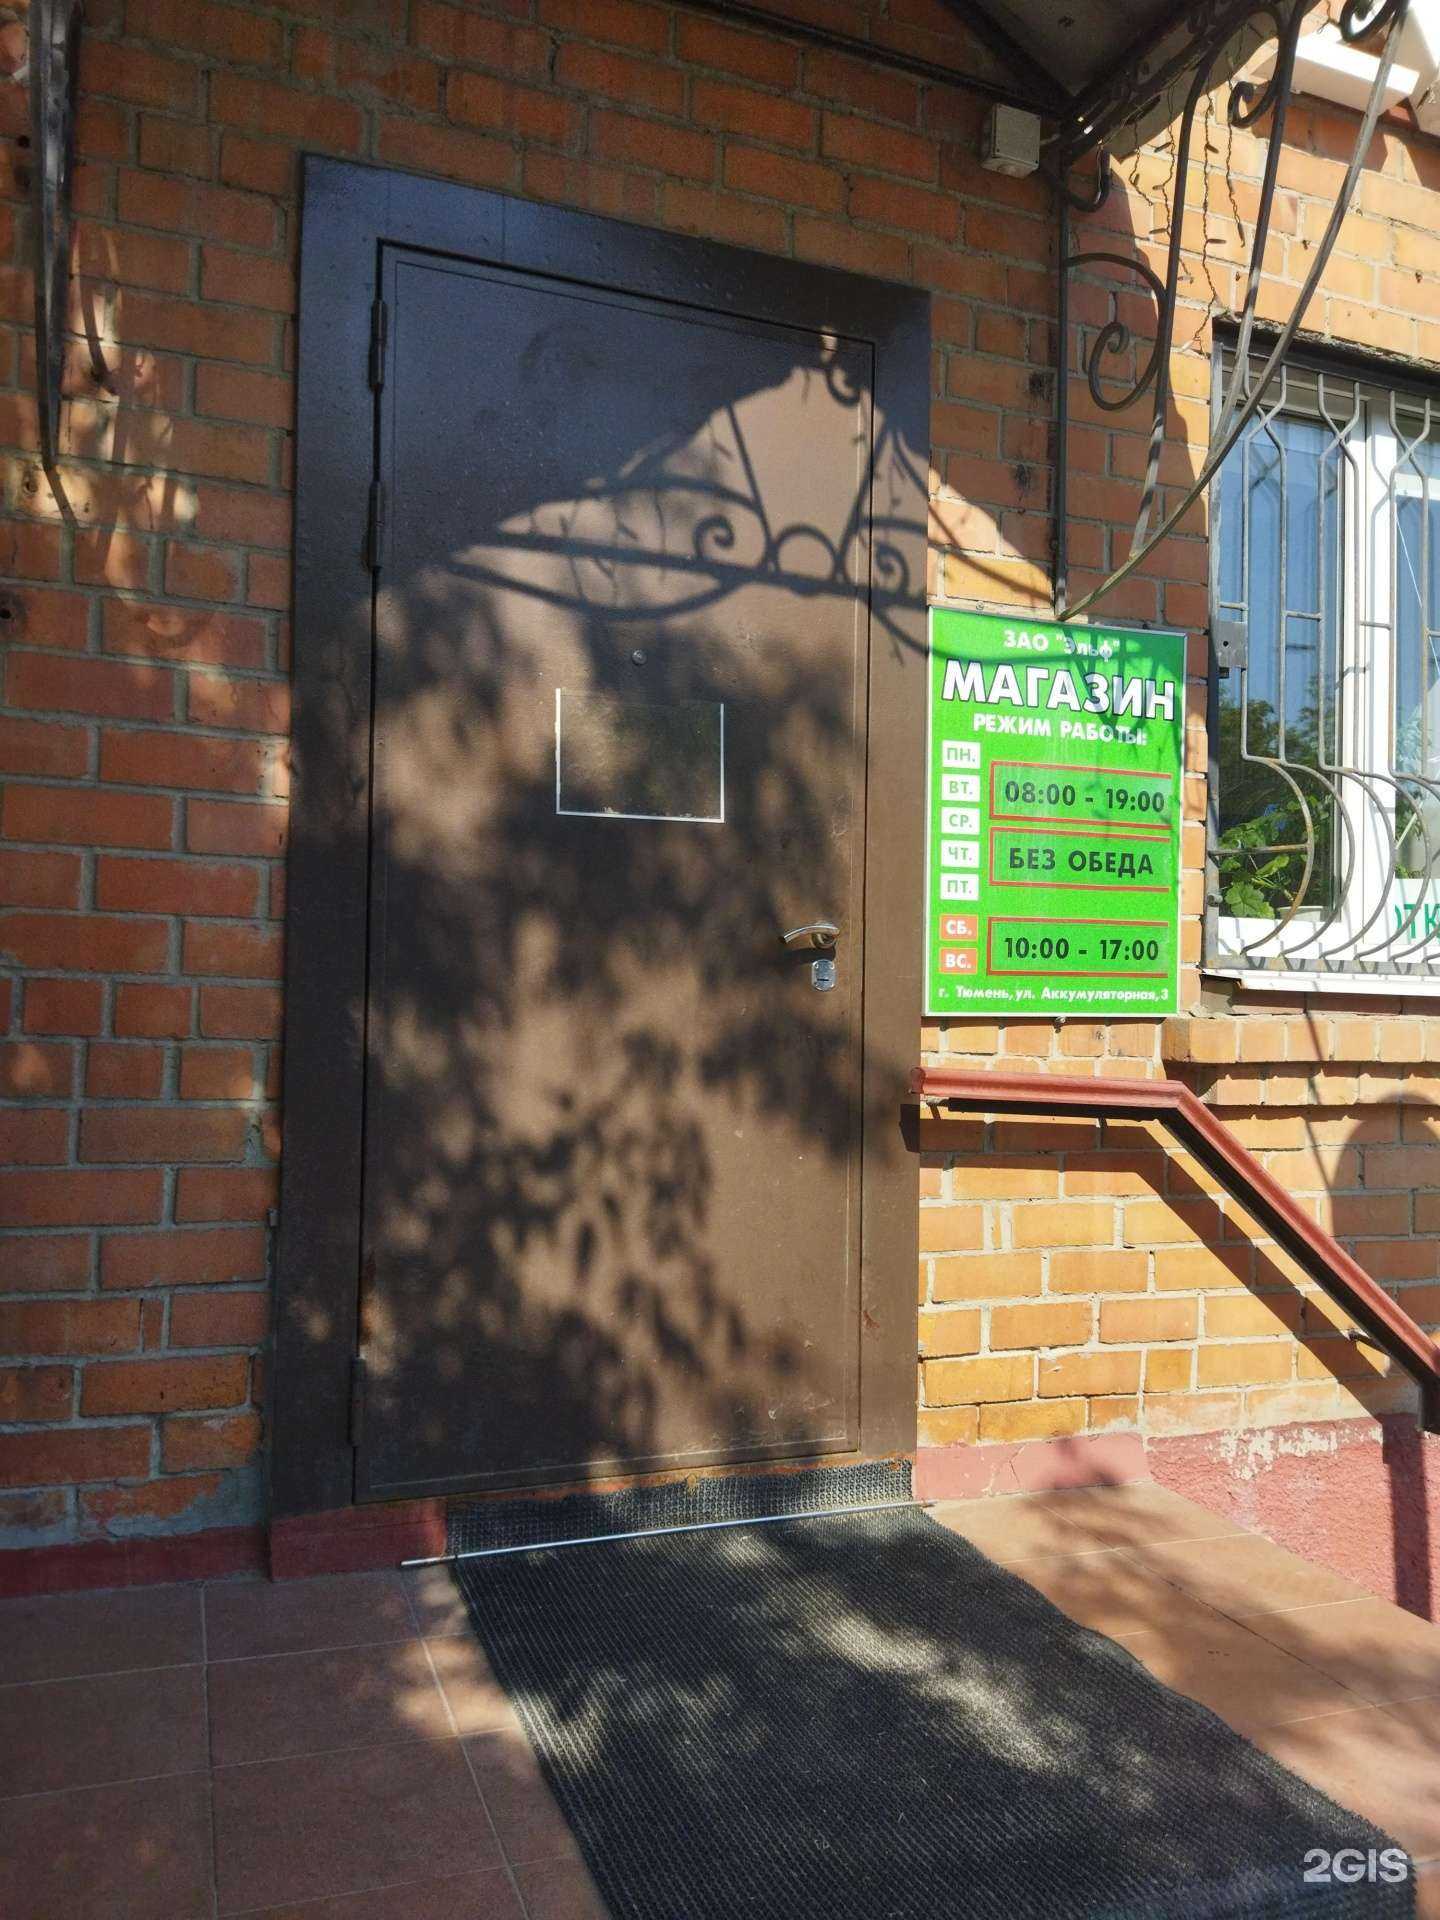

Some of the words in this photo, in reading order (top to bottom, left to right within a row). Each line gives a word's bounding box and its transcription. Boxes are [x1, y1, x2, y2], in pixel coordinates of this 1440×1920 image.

[1003, 630, 1049, 652] ЗАО
[941, 658, 1175, 721] МАГАЗИН
[973, 713, 1052, 737] РЕЖИМ
[946, 747, 976, 763] ПН.
[949, 781, 973, 796] ВТ.
[1005, 781, 1076, 806] 08:00
[1106, 788, 1165, 812] 19:00
[949, 813, 973, 828] СР.
[948, 847, 973, 861] ЧТ.
[1009, 847, 1056, 870] БЕЗ
[1068, 850, 1153, 878] ОБЕДА
[947, 880, 973, 894] ПТ.
[945, 920, 972, 936] СБ.
[1004, 937, 1070, 960] 10:00
[1100, 939, 1159, 961] 17:00
[945, 953, 972, 969] ВС.
[938, 988, 949, 998] г.
